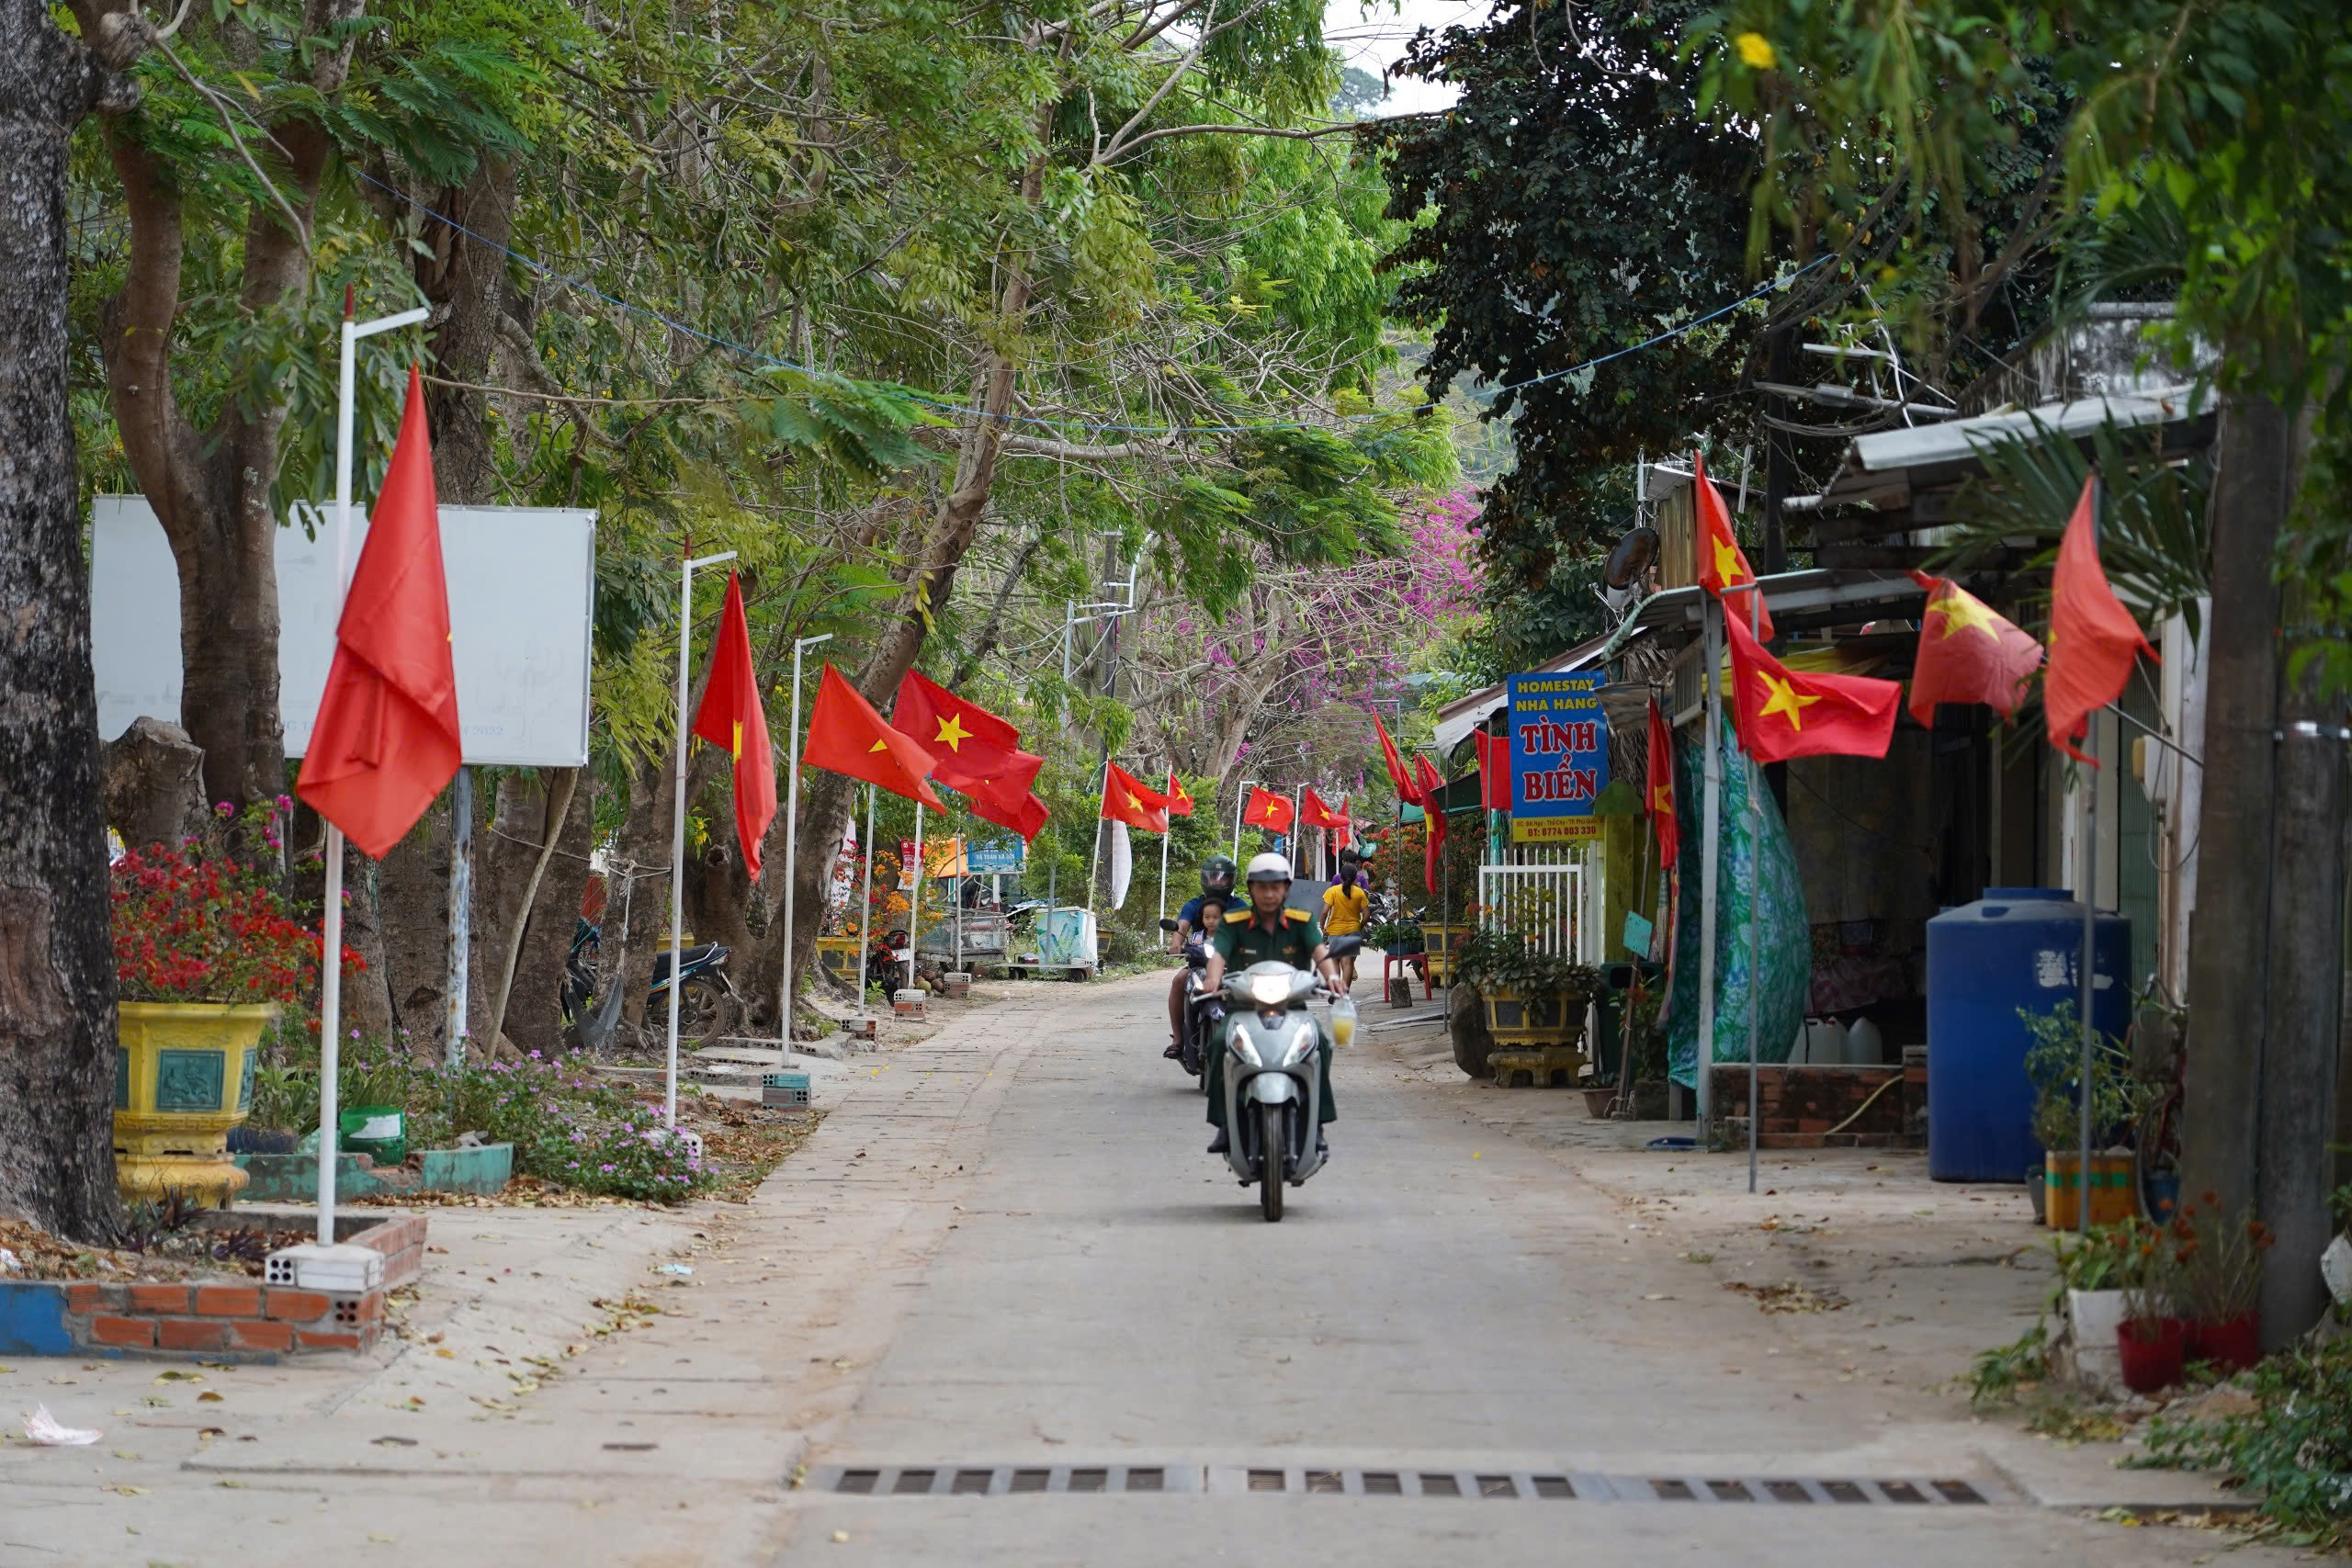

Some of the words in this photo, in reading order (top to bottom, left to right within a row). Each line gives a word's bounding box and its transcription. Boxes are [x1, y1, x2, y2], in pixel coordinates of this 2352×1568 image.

[1518, 680, 1595, 694] HOMESTAY
[1516, 697, 1549, 712] NHÀ
[1554, 696, 1598, 710] HÀNG
[1520, 715, 1597, 754] TÌNH
[1522, 753, 1598, 802] BIỂN
[1542, 827, 1562, 836] 0774
[1580, 826, 1596, 835] 330
